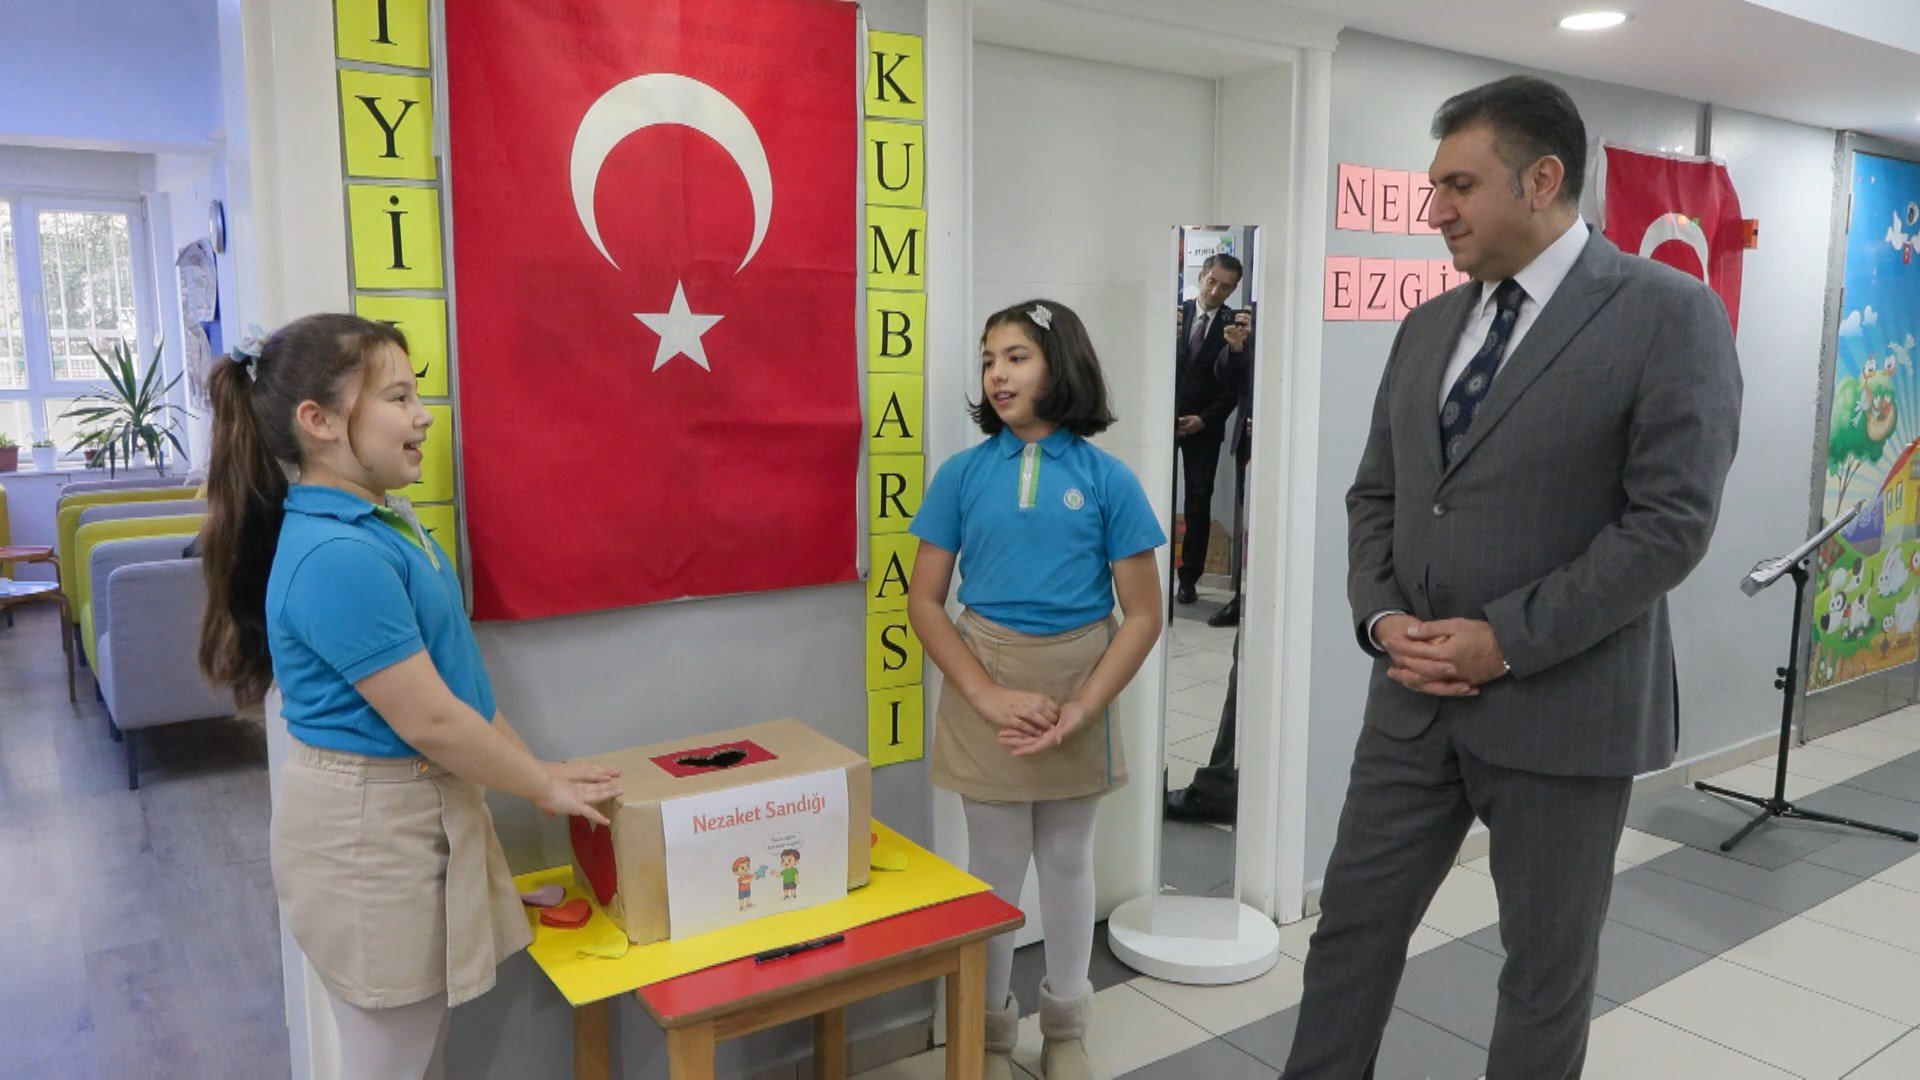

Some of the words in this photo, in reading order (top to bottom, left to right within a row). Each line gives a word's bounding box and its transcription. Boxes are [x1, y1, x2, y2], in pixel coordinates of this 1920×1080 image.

[870, 51, 919, 746] KUMBARASI
[692, 806, 761, 834] Nezaket
[766, 792, 826, 818] Sandığı
